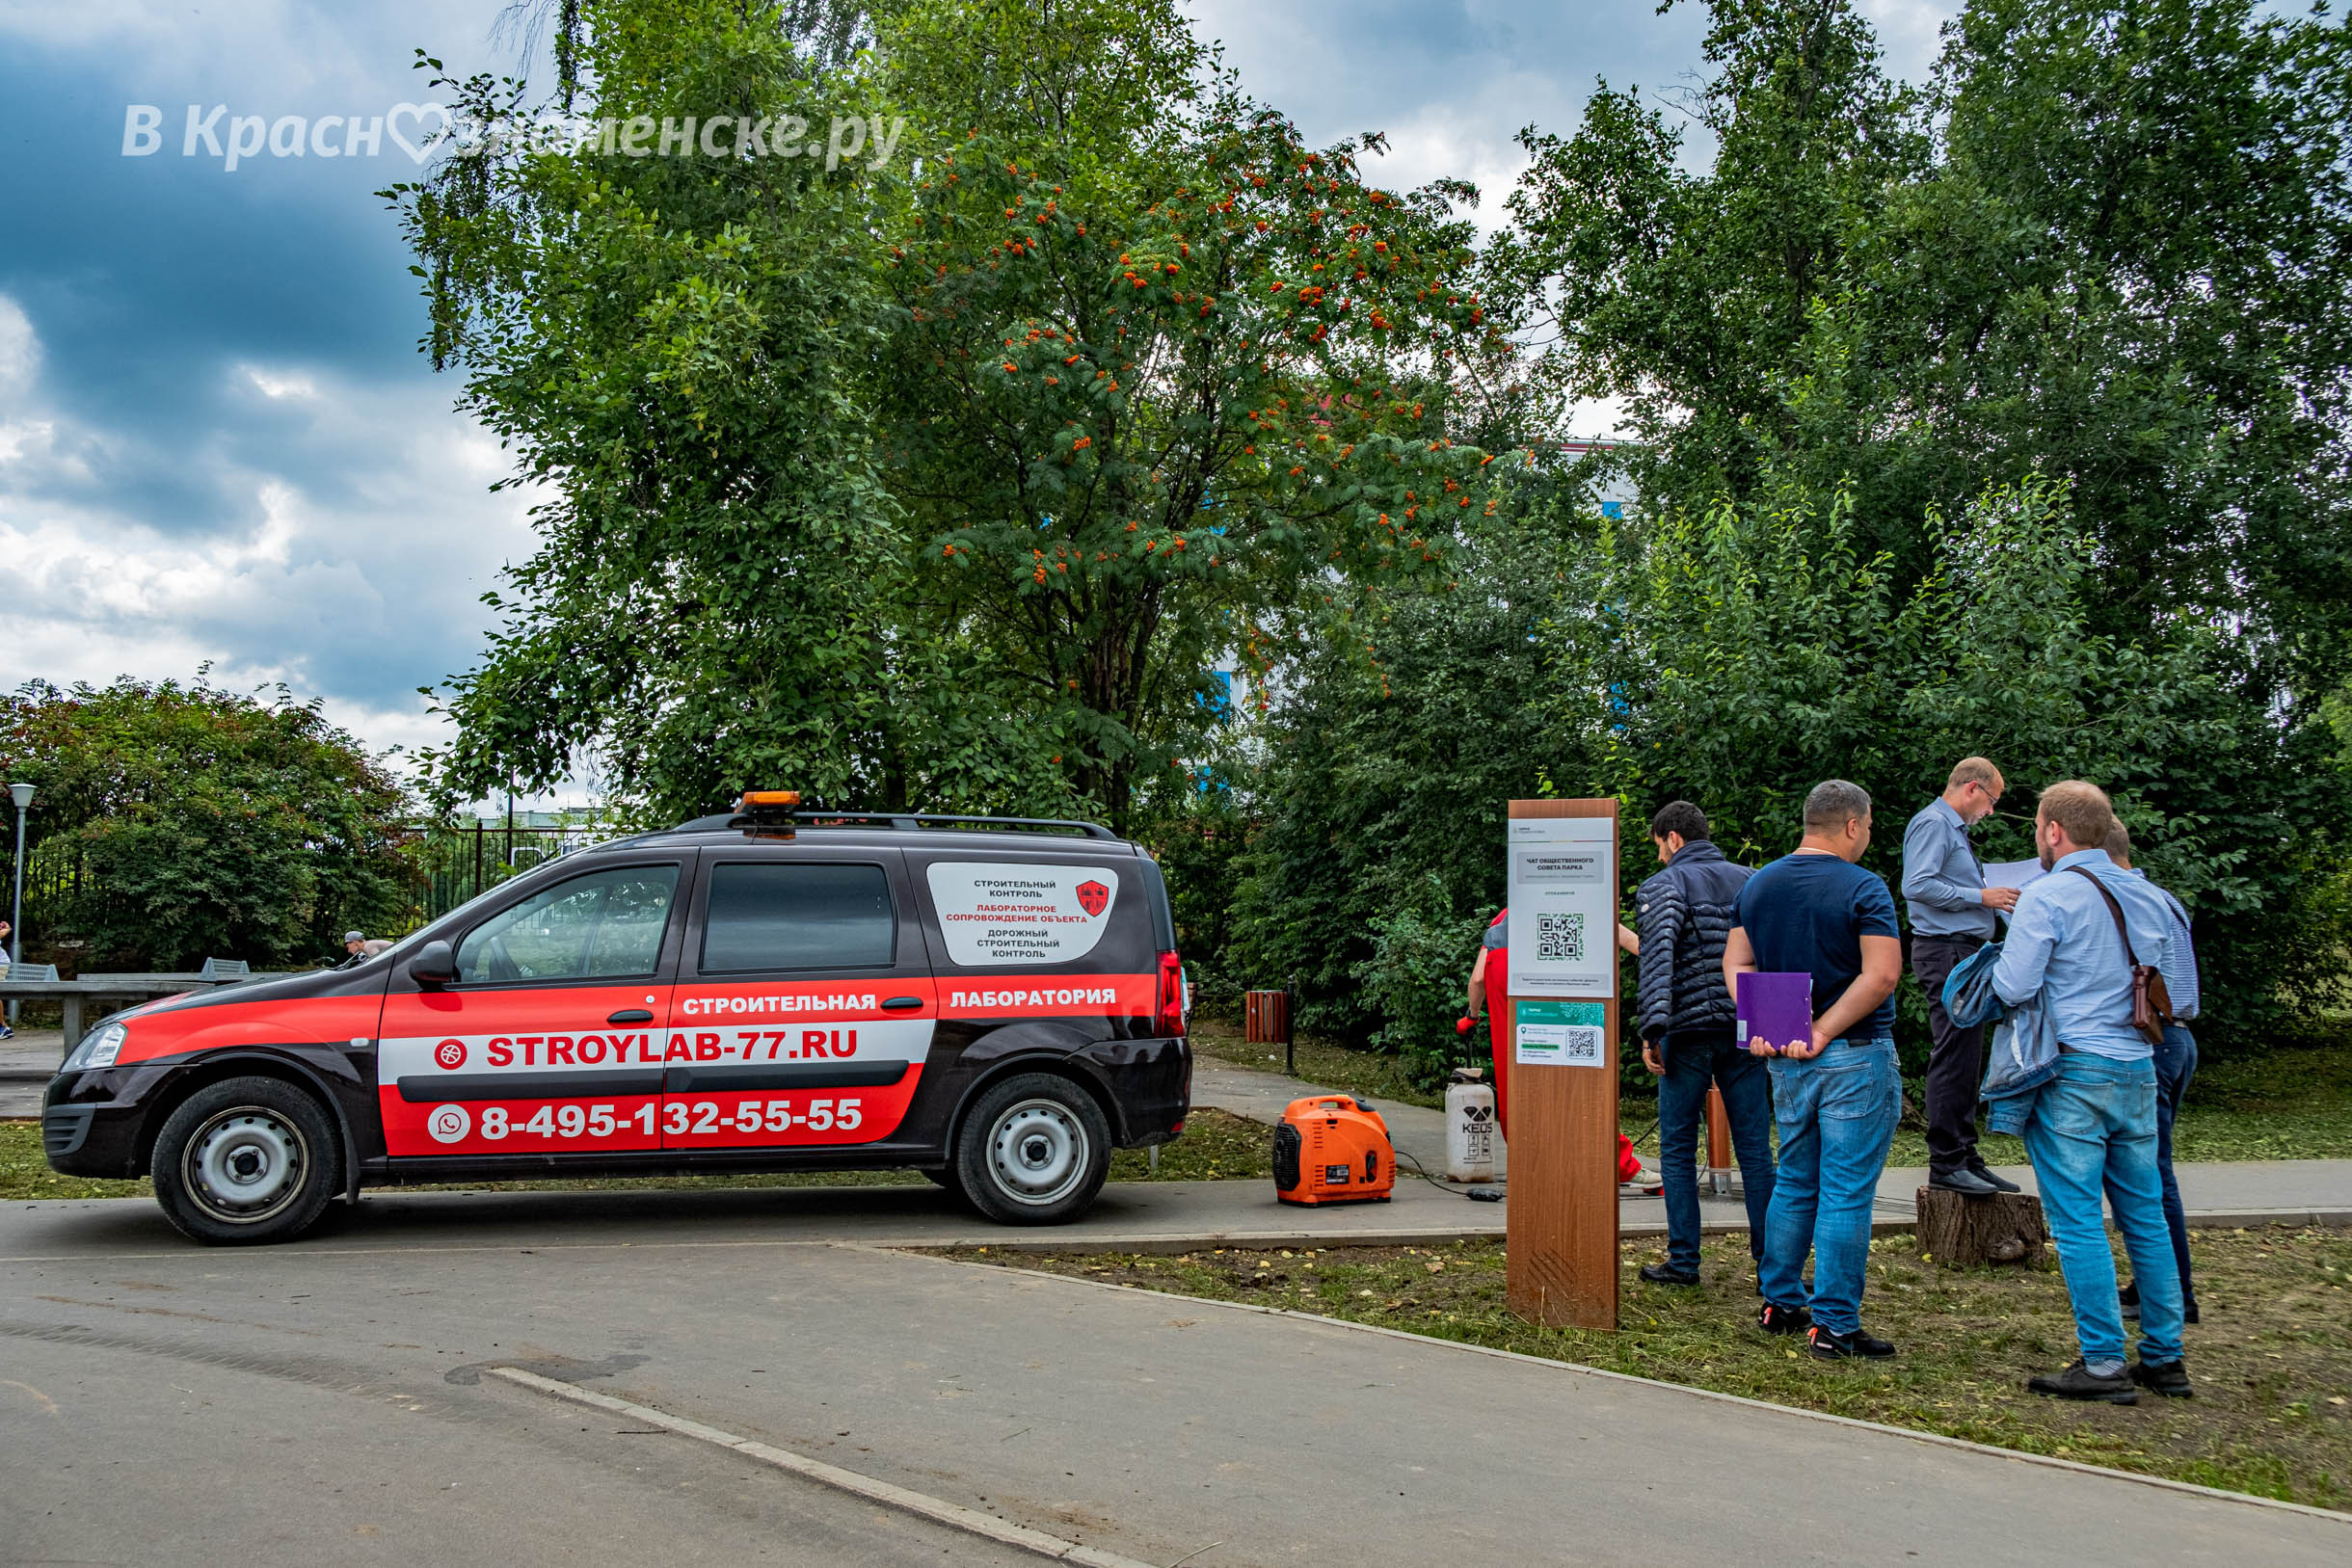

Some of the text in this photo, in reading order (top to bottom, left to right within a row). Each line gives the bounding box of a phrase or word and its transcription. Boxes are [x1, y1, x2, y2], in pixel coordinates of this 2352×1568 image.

[974, 880, 1056, 889] СТРОИТЕЛЬНЫЙ
[989, 890, 1043, 898] КОНТРОЛЬ
[976, 904, 1056, 913] ЛАБОРАТОРНОЕ
[946, 914, 1087, 923] СОПРОВОЖДЕНИЕ ОБЪЕКТА
[987, 929, 1048, 938] ДОРОЖНЫЙ
[976, 939, 1059, 948] СТРОИТЕЛЬНЫЙ
[992, 949, 1046, 958] КОНТРОЛЬ
[682, 988, 1116, 1015] СТРОИТЕЛЬНАЯ ЛАБОРАТОРИЯ
[487, 1029, 858, 1067] STROYLAB-77.RU
[480, 1099, 862, 1140] 8-495-132-55-55
[1462, 1123, 1493, 1134] KEOS
